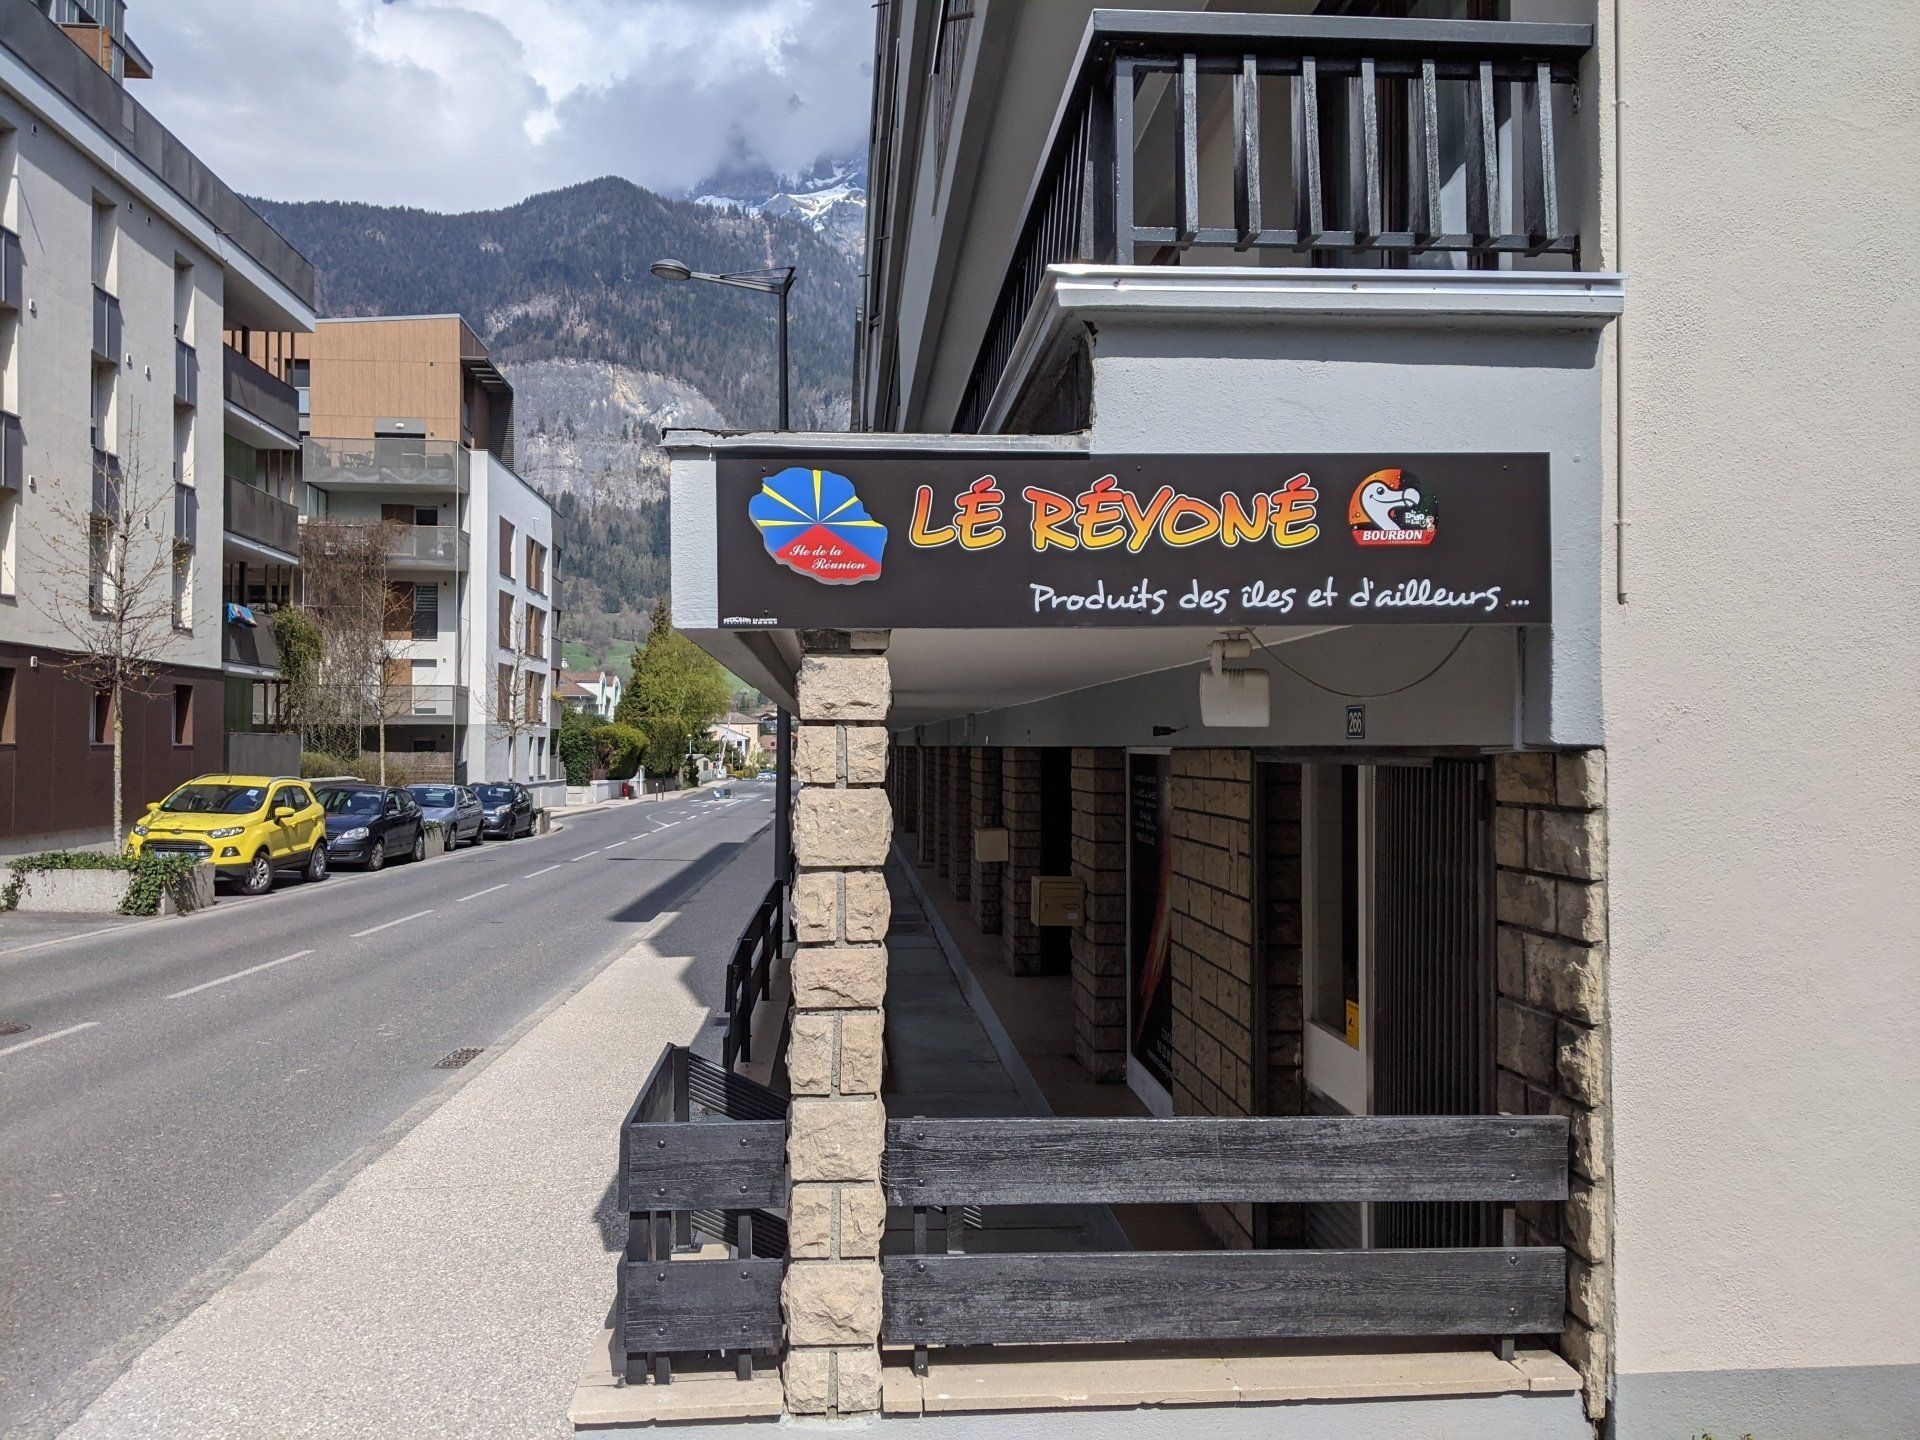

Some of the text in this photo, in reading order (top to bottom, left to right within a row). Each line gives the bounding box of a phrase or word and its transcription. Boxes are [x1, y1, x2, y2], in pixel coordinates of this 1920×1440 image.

[909, 473, 1320, 554] LÉ RÉYONÉ
[1362, 530, 1423, 541] BOURBON
[789, 544, 844, 556] Ile de la
[811, 557, 868, 570] Réunion
[1029, 578, 1168, 615] Produits
[1178, 578, 1230, 615] des
[1241, 579, 1297, 614] îles
[1307, 577, 1338, 608] et
